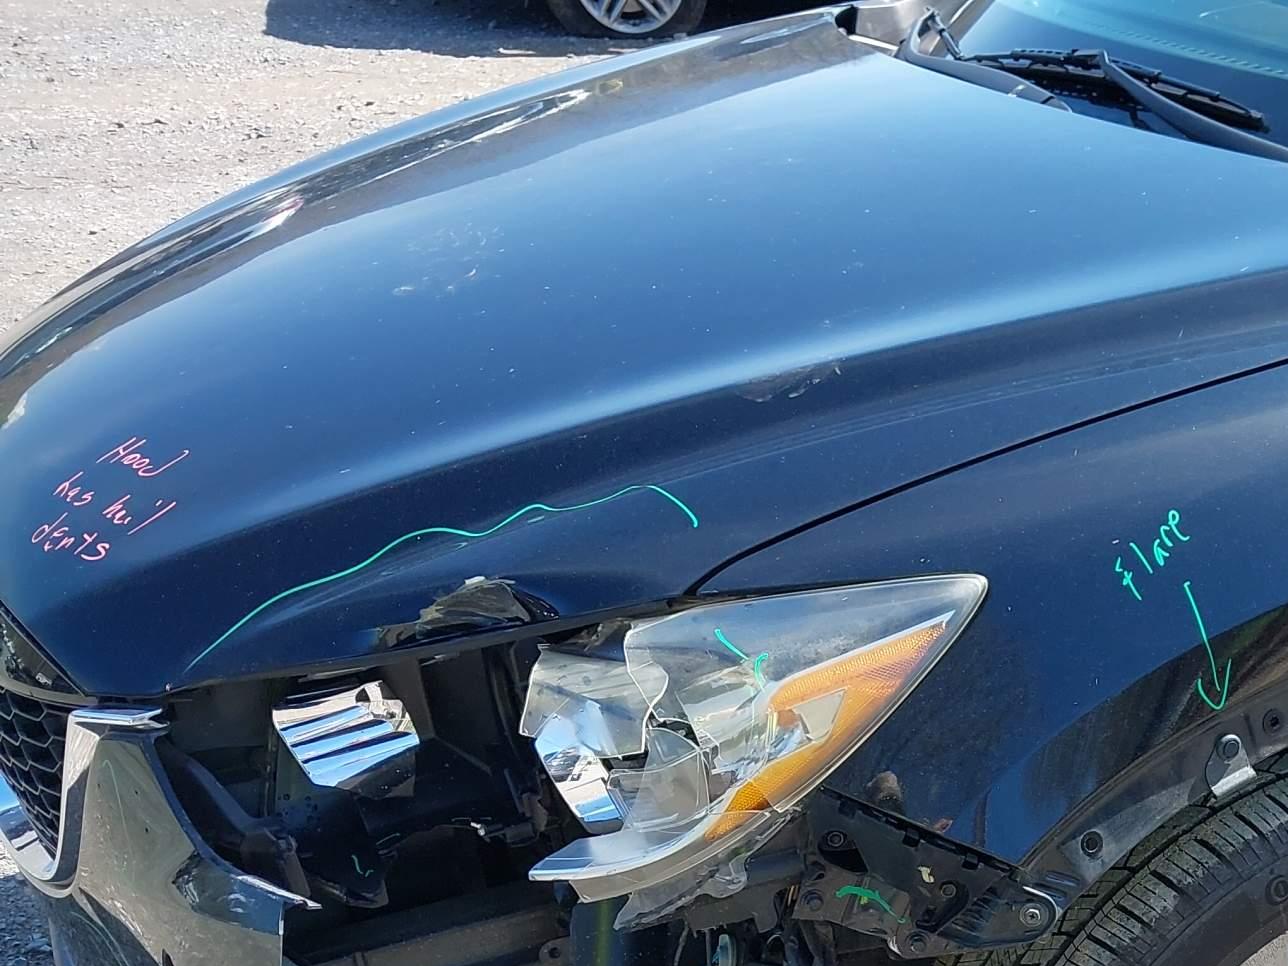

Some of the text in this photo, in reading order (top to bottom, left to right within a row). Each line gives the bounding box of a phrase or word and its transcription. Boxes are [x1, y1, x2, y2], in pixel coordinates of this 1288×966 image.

[95, 436, 190, 477] Hood
[53, 471, 177, 536] has hail
